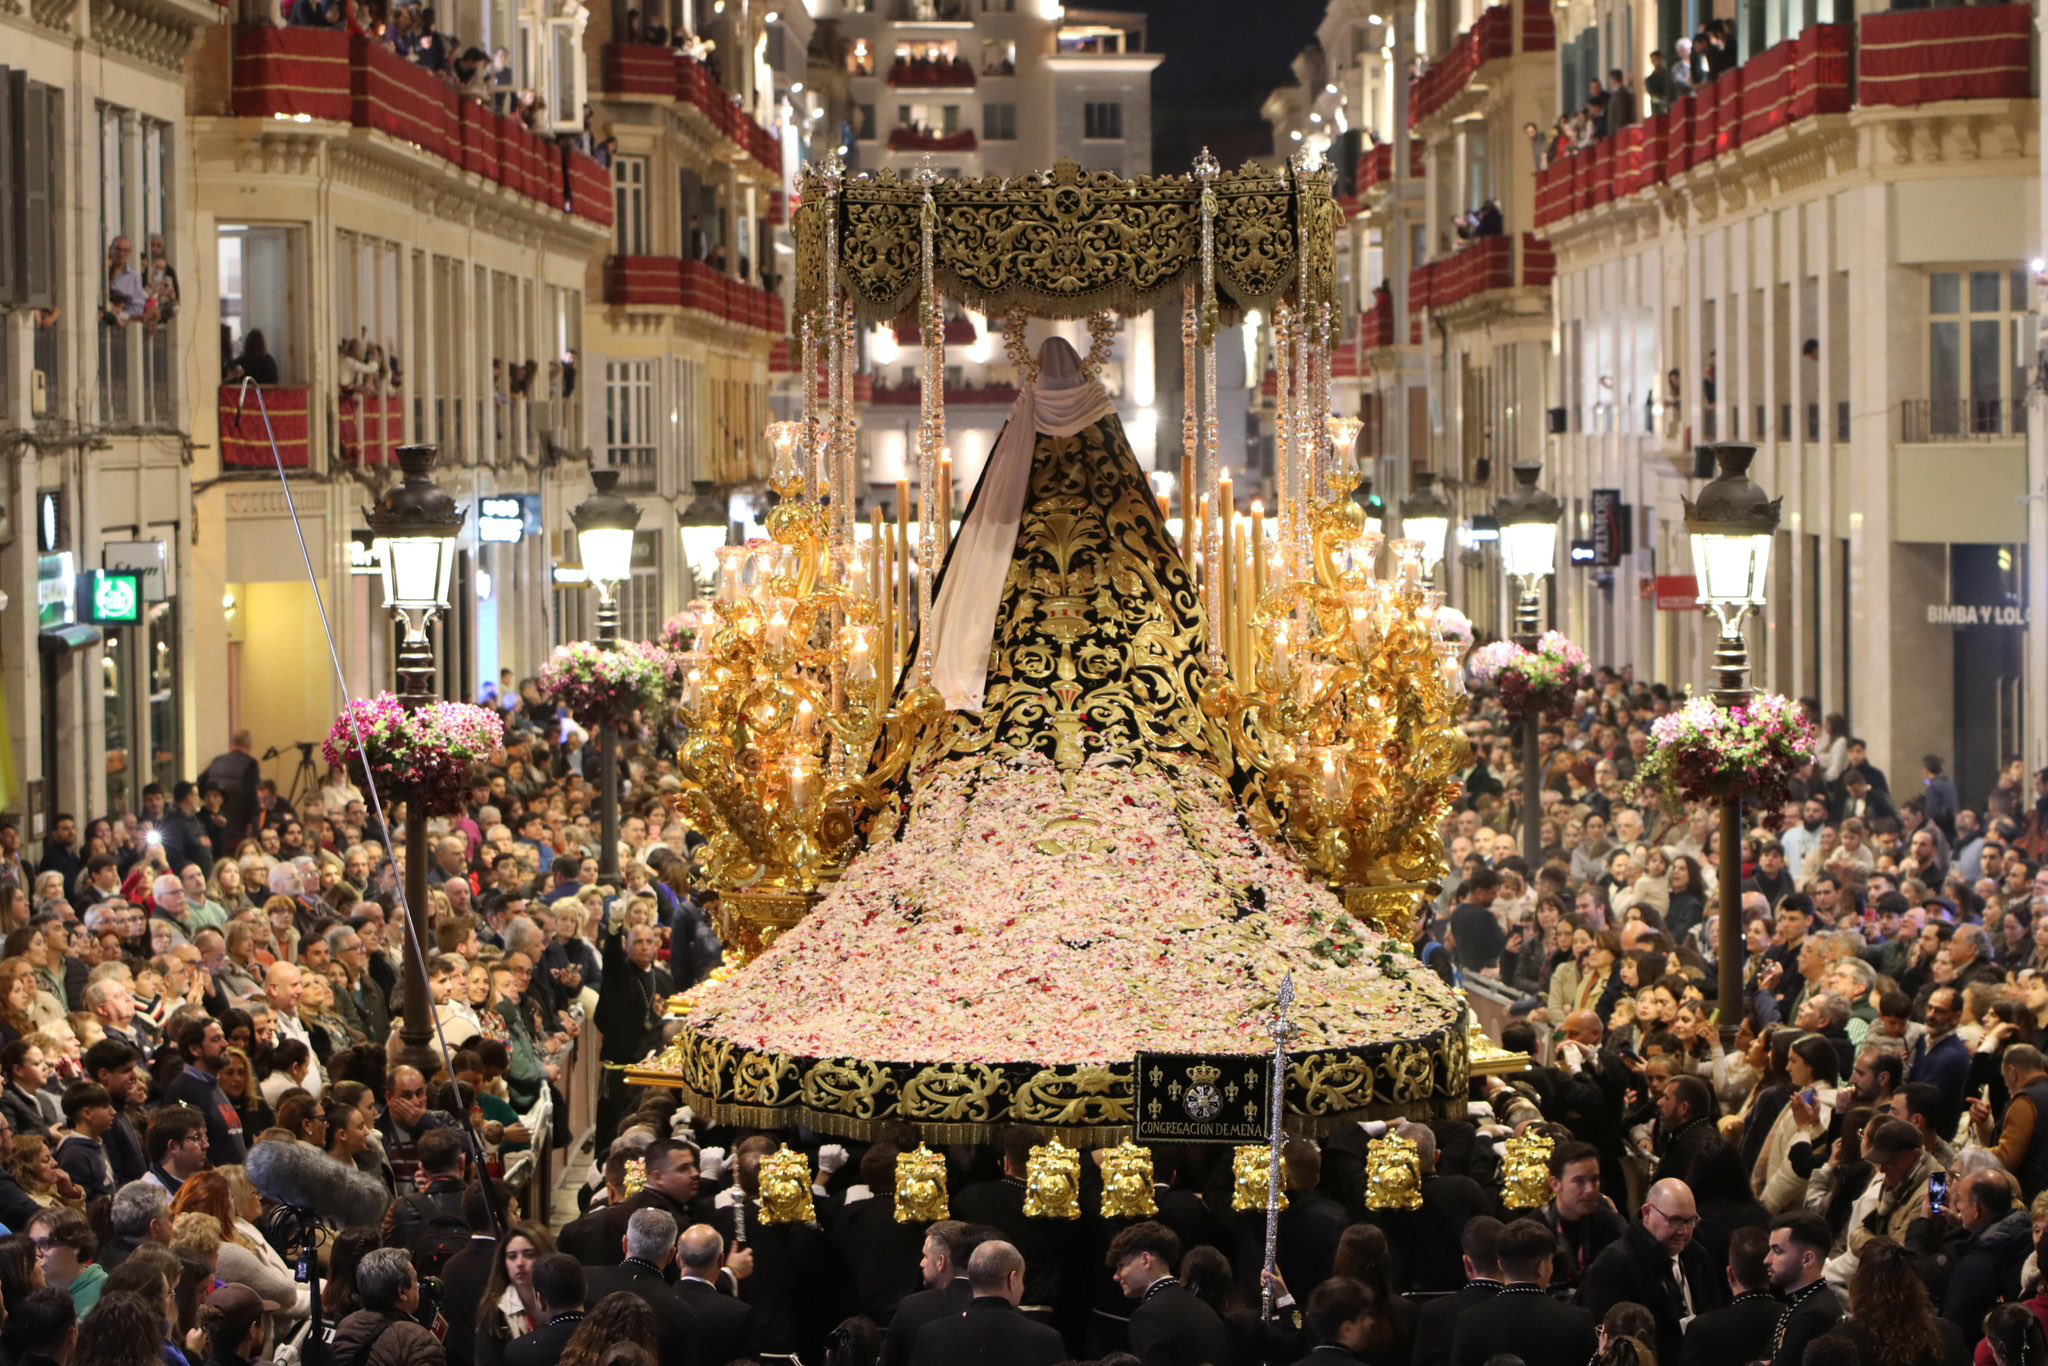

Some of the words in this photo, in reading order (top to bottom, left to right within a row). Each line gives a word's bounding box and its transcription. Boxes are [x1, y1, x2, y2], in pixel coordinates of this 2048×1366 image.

[1927, 605, 1978, 624] BIMBA
[1981, 606, 1993, 624] Y
[1216, 1123, 1229, 1135] DE
[1230, 1123, 1262, 1136] MENA
